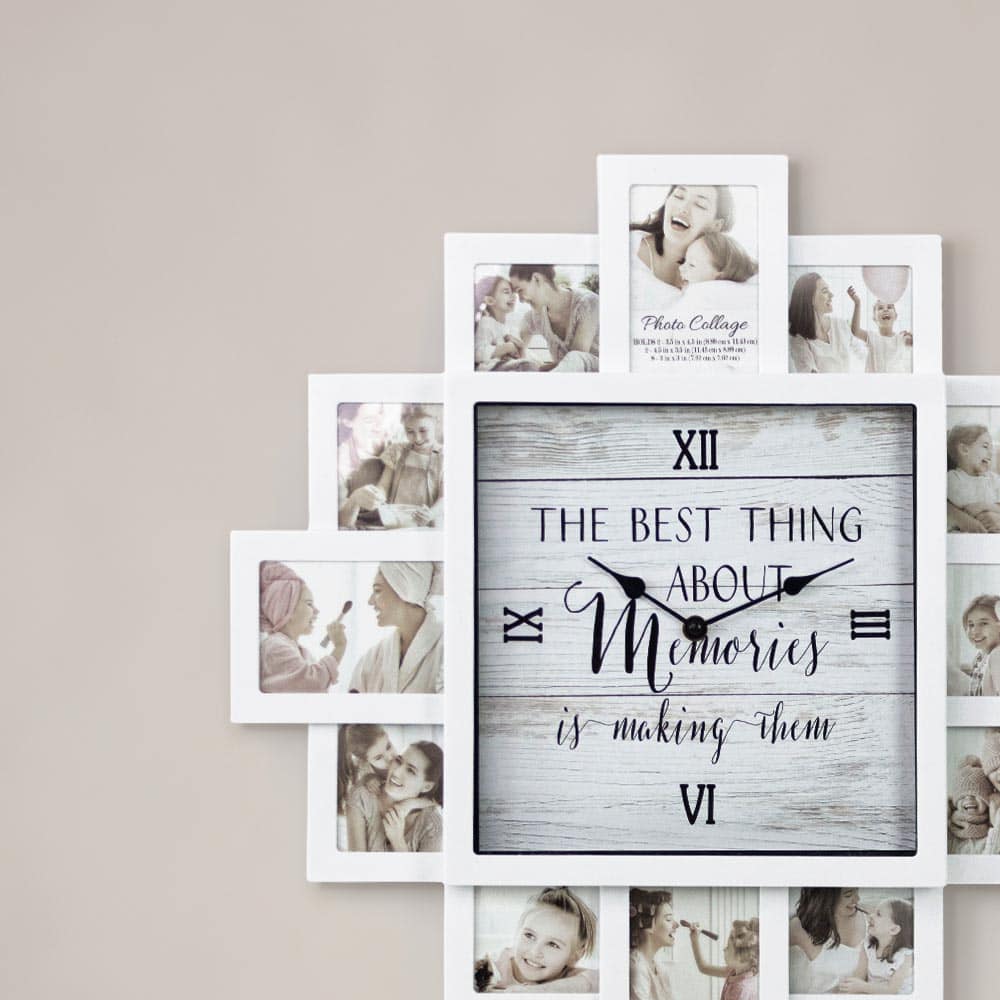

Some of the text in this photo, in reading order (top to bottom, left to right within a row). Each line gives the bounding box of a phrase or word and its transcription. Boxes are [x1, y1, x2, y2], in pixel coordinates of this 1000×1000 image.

[641, 314, 749, 338] Photo Collage
[672, 429, 719, 471] XII
[531, 506, 863, 543] THE BEST THING
[666, 565, 793, 602] ABOUT
[503, 606, 543, 643] IX
[563, 581, 830, 693] Memories
[850, 609, 890, 640] III
[557, 698, 836, 764] is making them
[679, 784, 716, 825] VI
